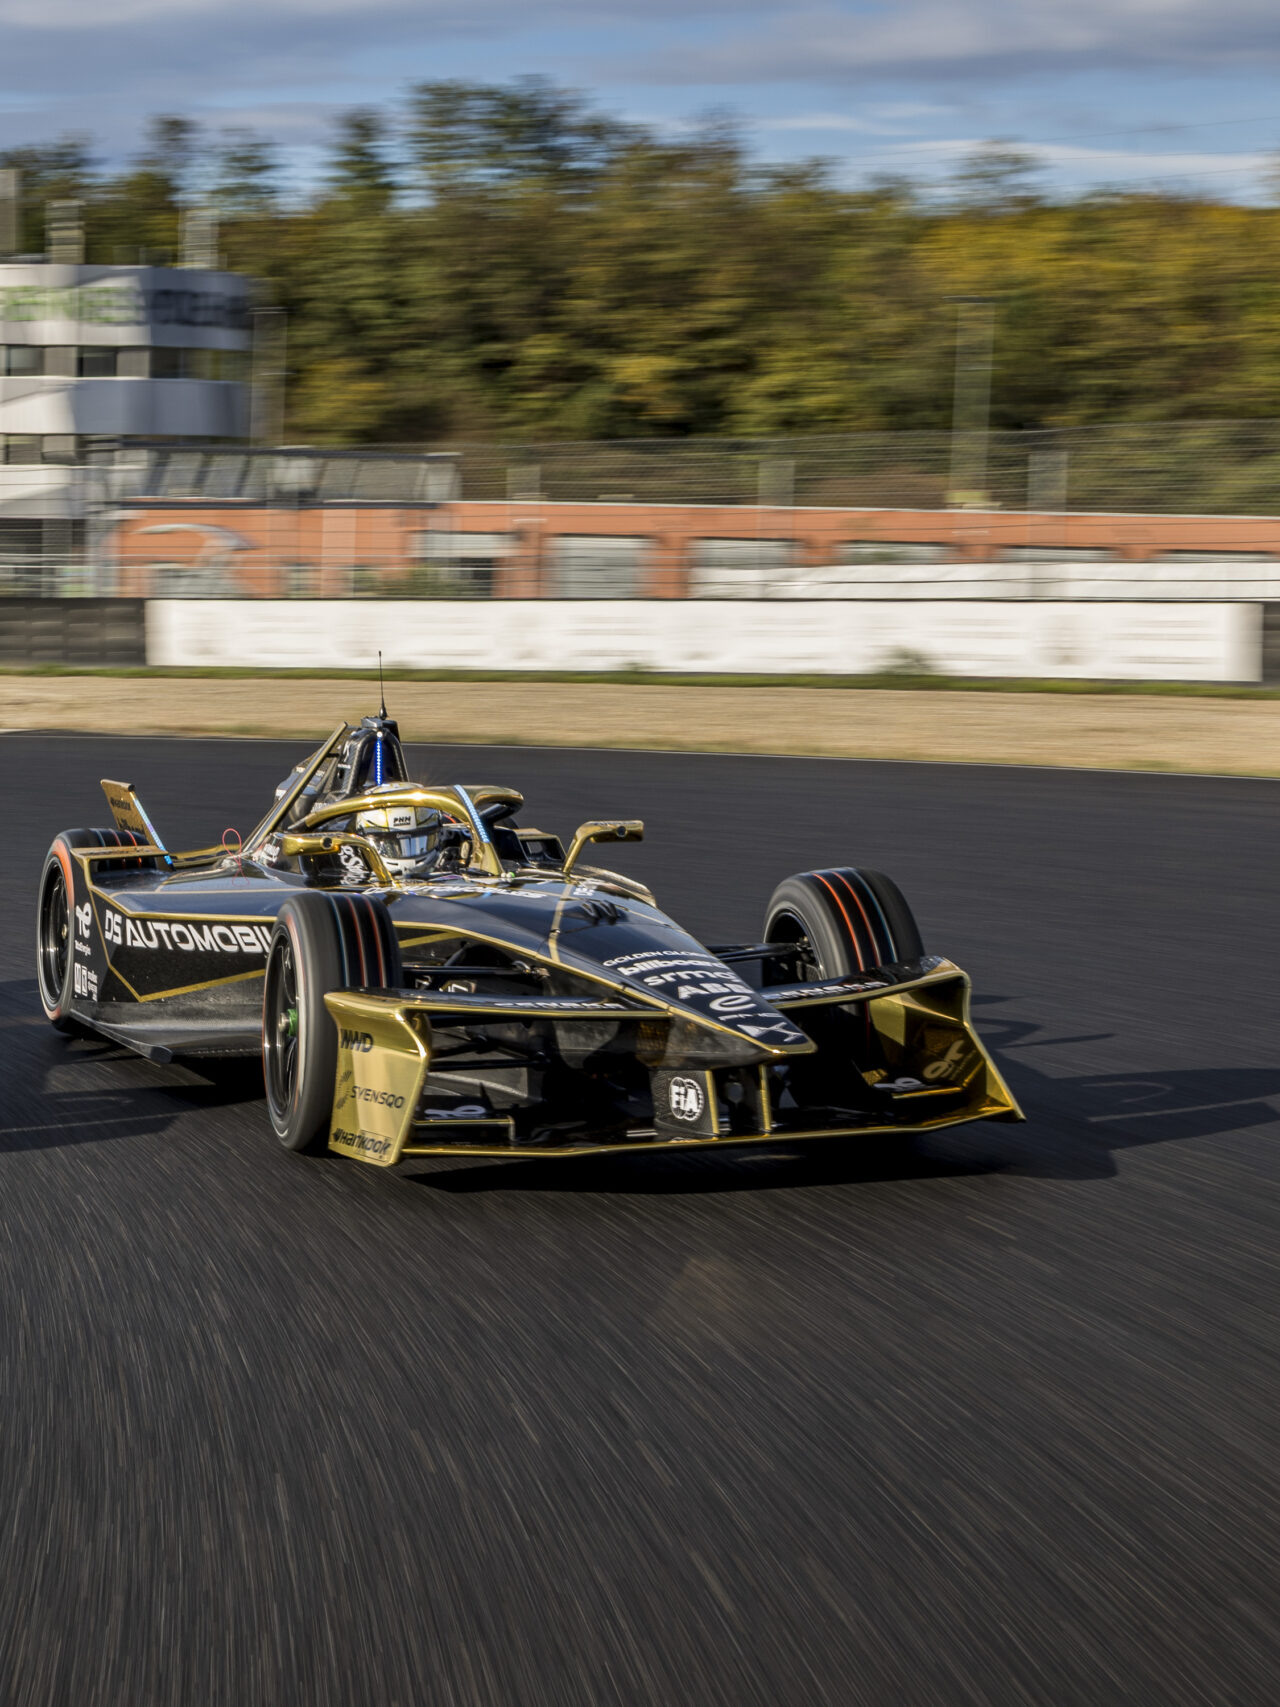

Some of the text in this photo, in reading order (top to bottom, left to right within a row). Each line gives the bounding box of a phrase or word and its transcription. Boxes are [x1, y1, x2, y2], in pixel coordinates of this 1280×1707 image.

[104, 909, 123, 945] DS
[602, 950, 664, 967] GOLDEN
[677, 983, 755, 999] ABB
[350, 1085, 406, 1109] SVENSQO
[671, 1084, 700, 1113] FIA
